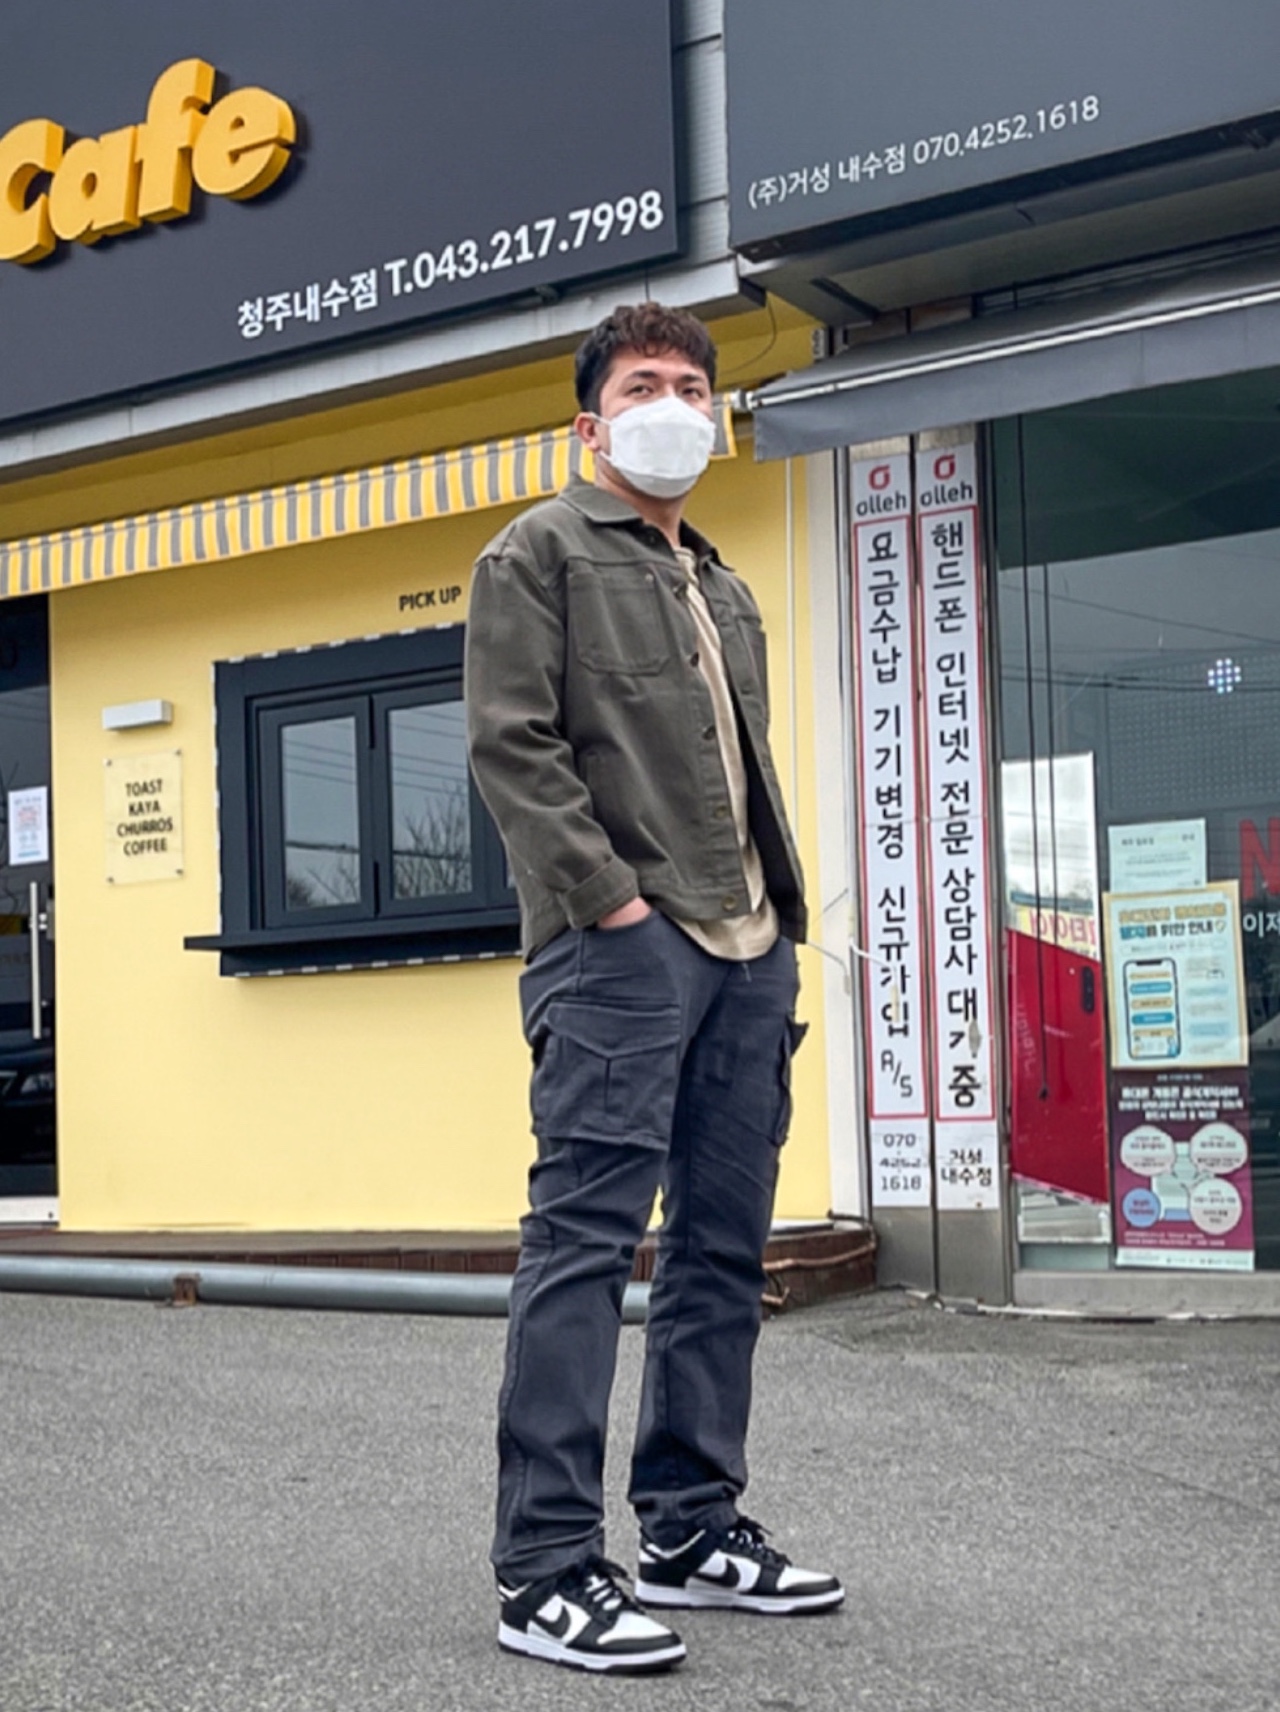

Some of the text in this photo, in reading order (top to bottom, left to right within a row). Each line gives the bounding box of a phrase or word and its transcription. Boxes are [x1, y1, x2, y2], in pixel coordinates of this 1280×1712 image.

[0, 59, 296, 264] Cafe
[747, 94, 1100, 210] (주)거성 내수점 070.4252.1618
[238, 190, 665, 339] 청주내수점 T.043.217.7998
[856, 491, 907, 518] olleh
[920, 481, 974, 508] olleh
[399, 585, 462, 612] PICK UP
[931, 519, 967, 634] 핸드폰
[867, 531, 902, 685] 요금수납
[936, 650, 970, 765] 인터넷
[125, 777, 163, 797] TOAST
[128, 799, 161, 817] KAYA
[873, 704, 904, 860] 기기변경
[117, 816, 174, 837] CHURROS
[940, 779, 973, 856] 전문
[123, 837, 168, 856] COFFEE
[942, 867, 977, 976] 상담사
[883, 1133, 917, 1148] 070
[881, 1175, 922, 1192] 1618
